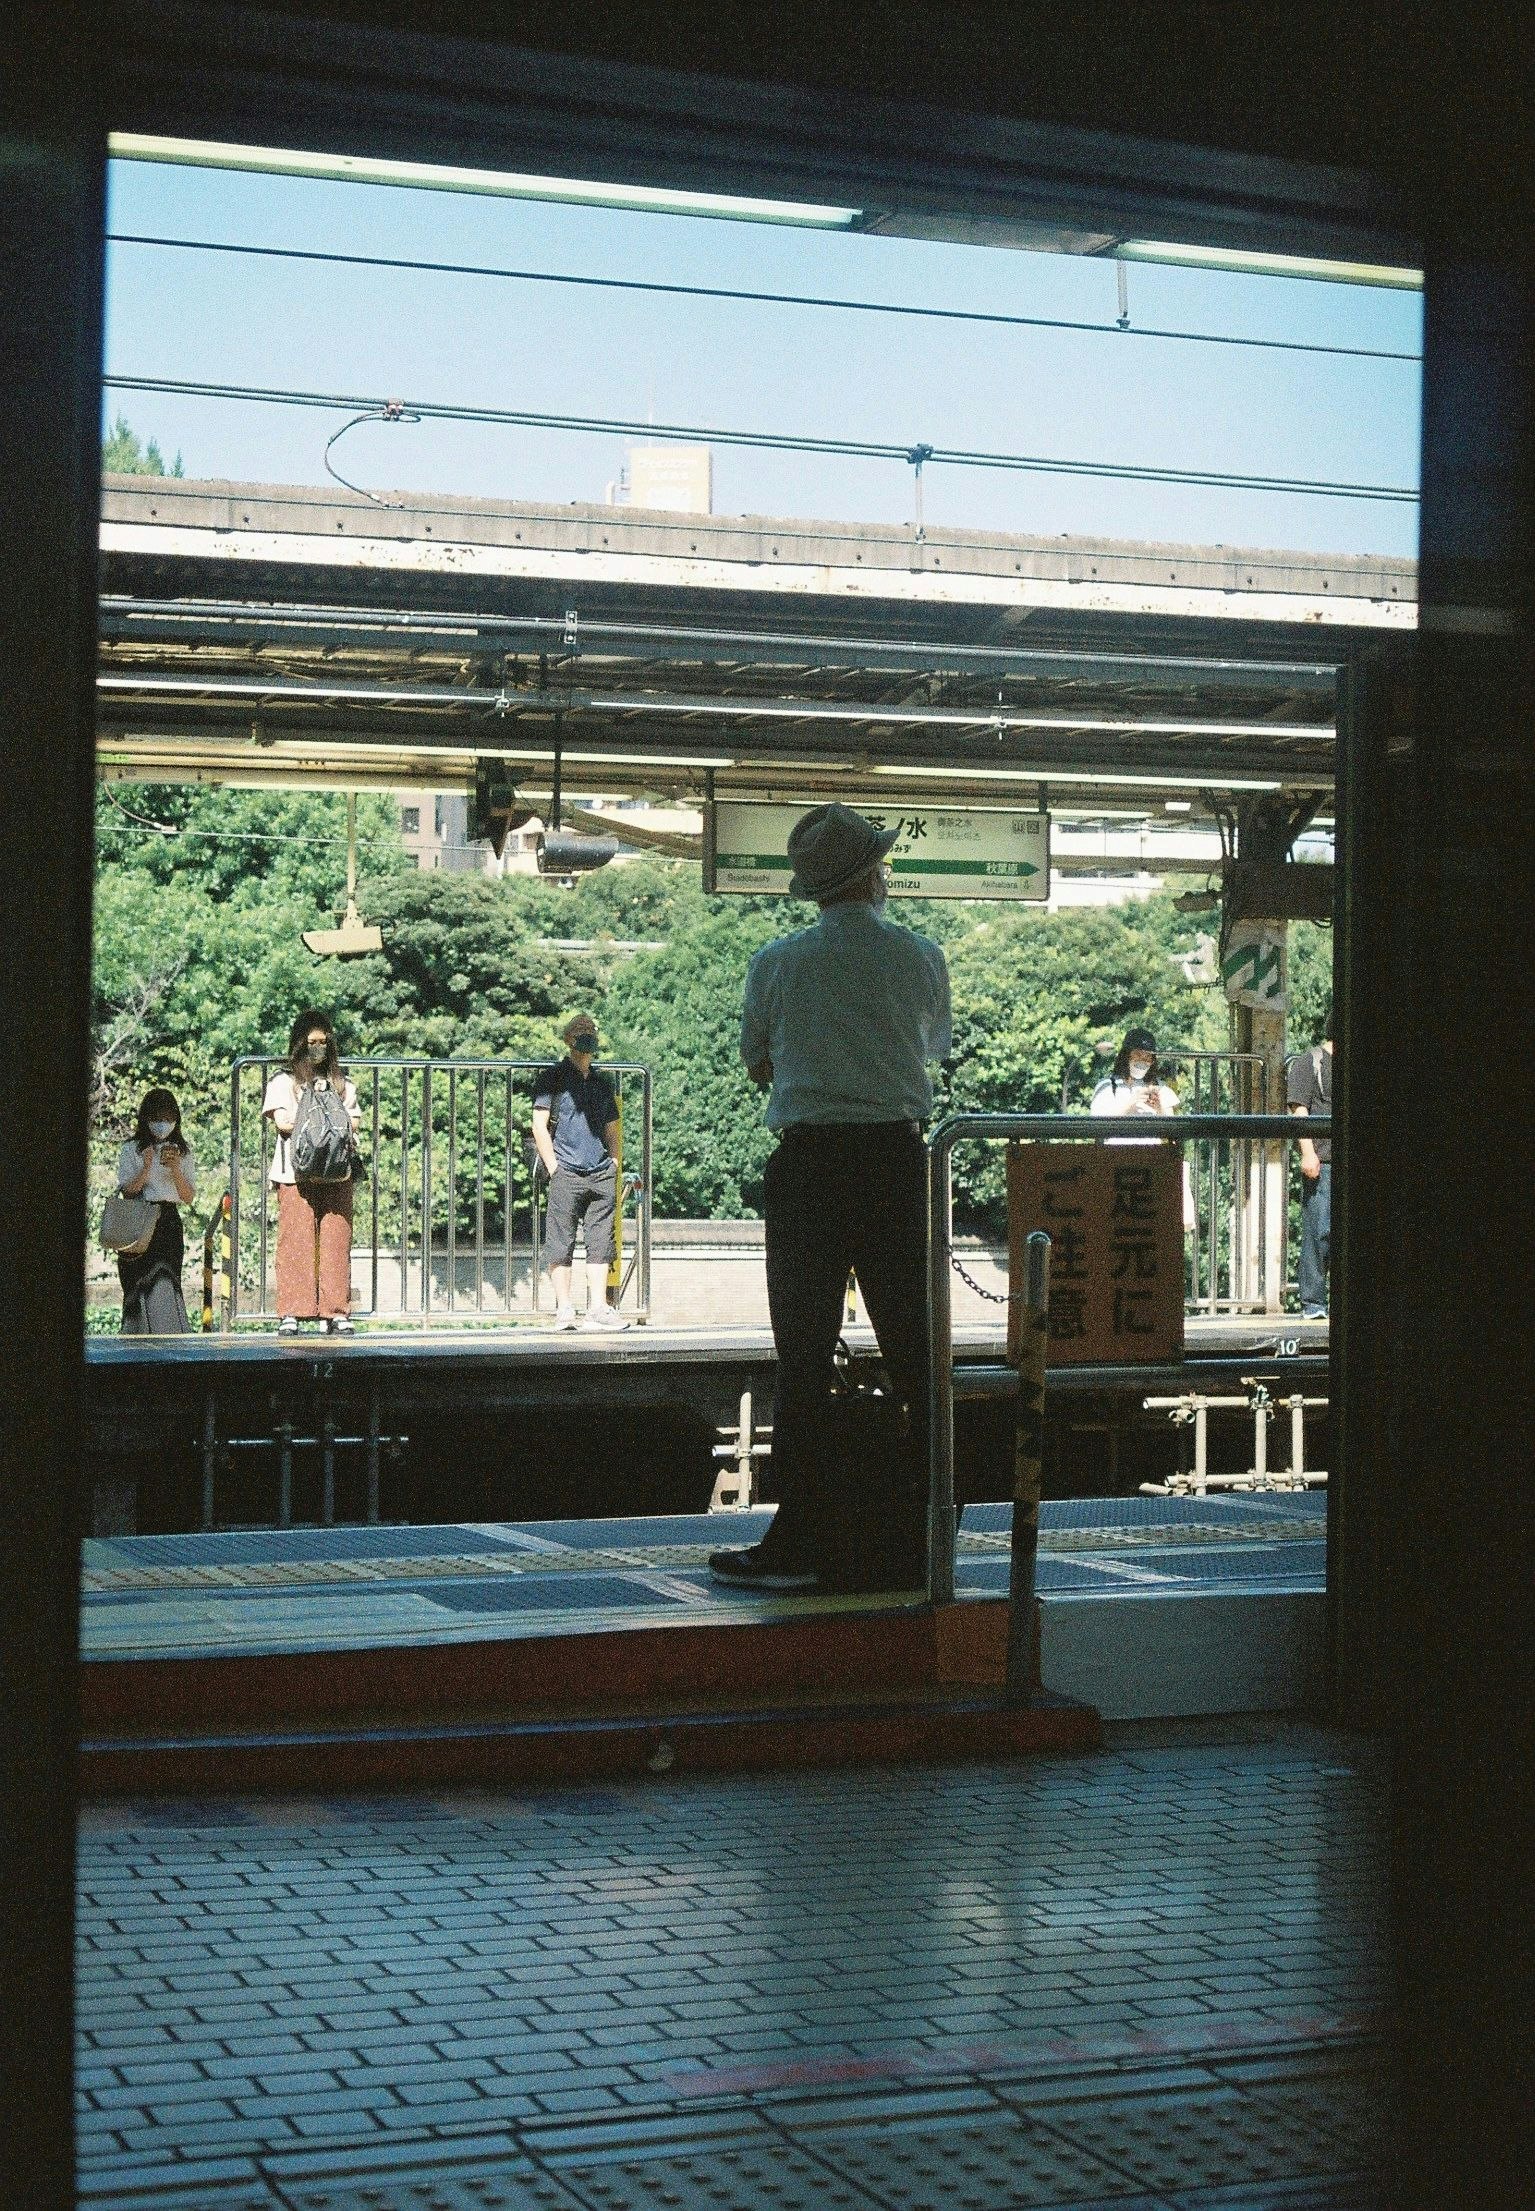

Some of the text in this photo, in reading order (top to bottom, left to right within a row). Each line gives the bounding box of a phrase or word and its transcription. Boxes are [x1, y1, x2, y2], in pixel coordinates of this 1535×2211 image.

[865, 814, 927, 839] 茶ノ水
[887, 879, 920, 889] omizu
[1109, 1166, 1157, 1335] 足元に
[1280, 1340, 1297, 1355] 10
[313, 1363, 333, 1378] 12
